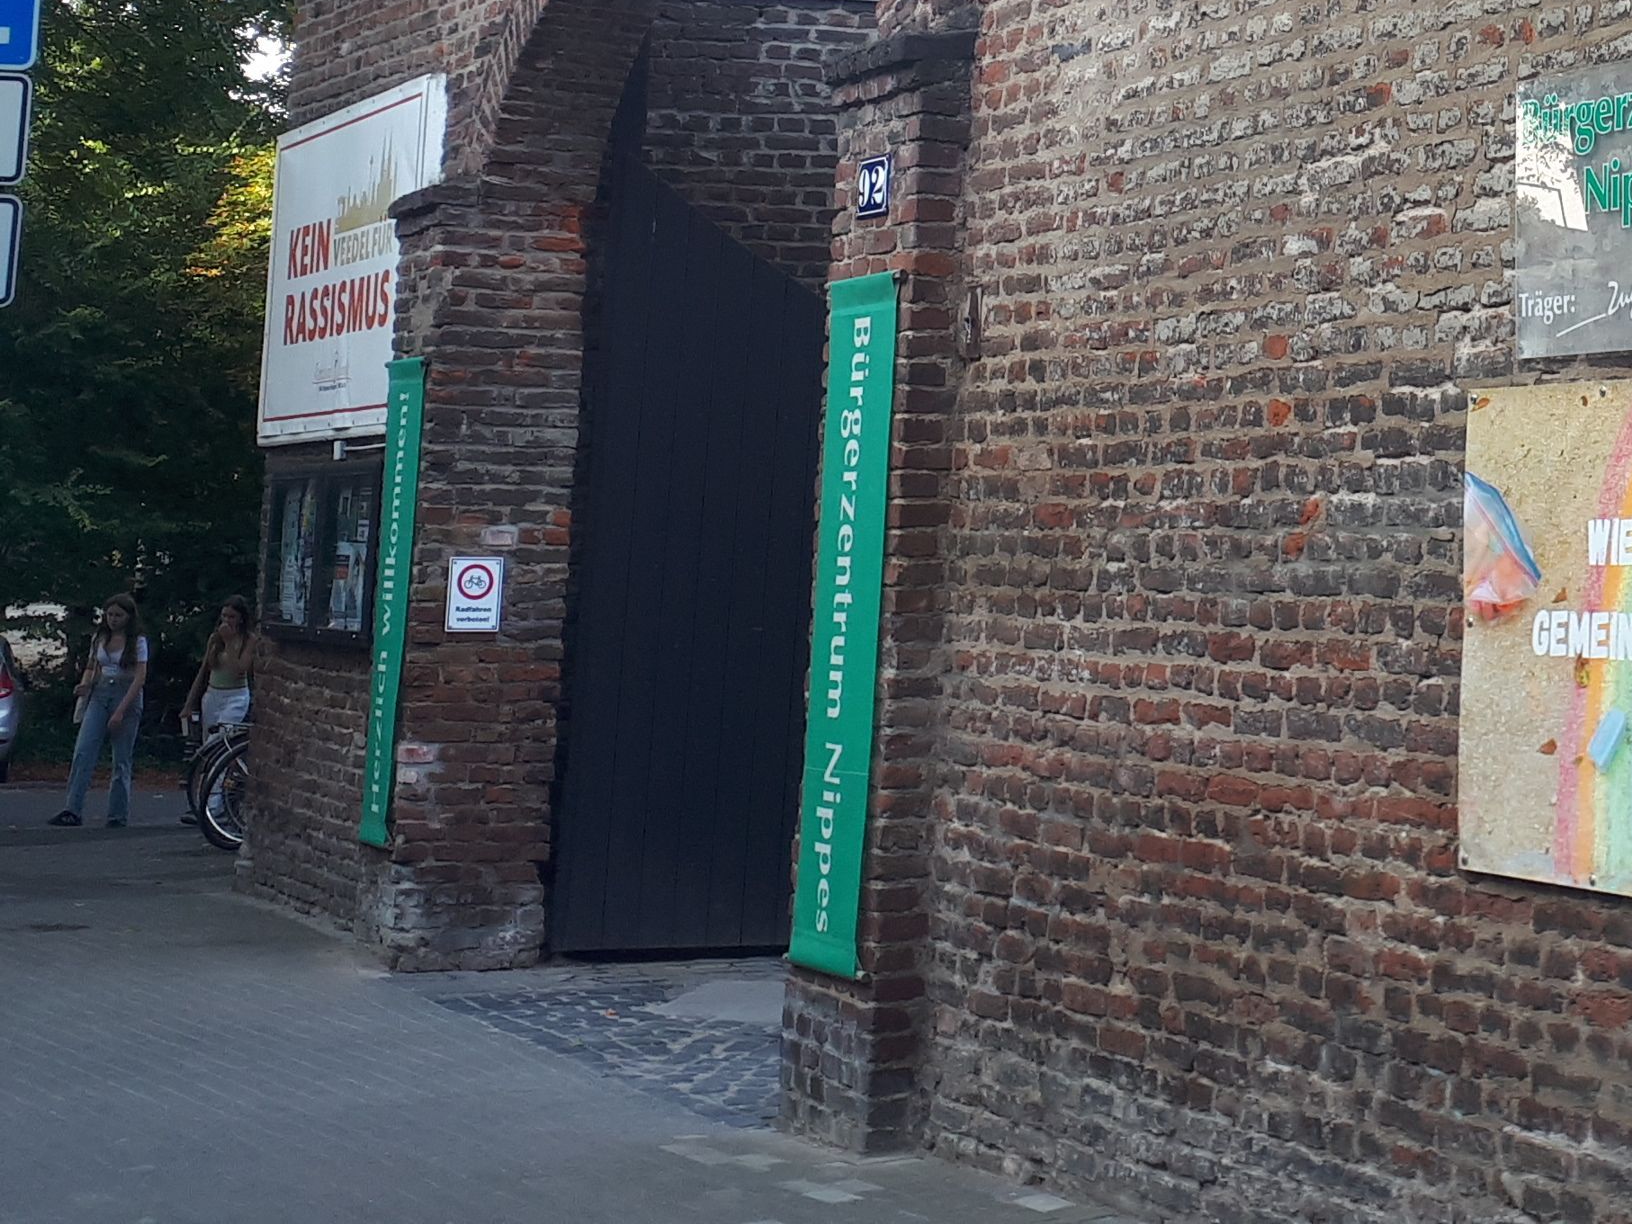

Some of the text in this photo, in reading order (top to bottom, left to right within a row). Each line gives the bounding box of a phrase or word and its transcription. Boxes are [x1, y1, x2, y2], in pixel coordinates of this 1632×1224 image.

[858, 165, 885, 208] 92
[287, 215, 393, 280] KEIN VEEDEL FÜR
[283, 269, 391, 346] RASSISMUS
[1519, 290, 1577, 325] Träger:
[370, 391, 410, 814] Herzlich willkommen!
[814, 315, 872, 934] Bürgerzentrum Nippes
